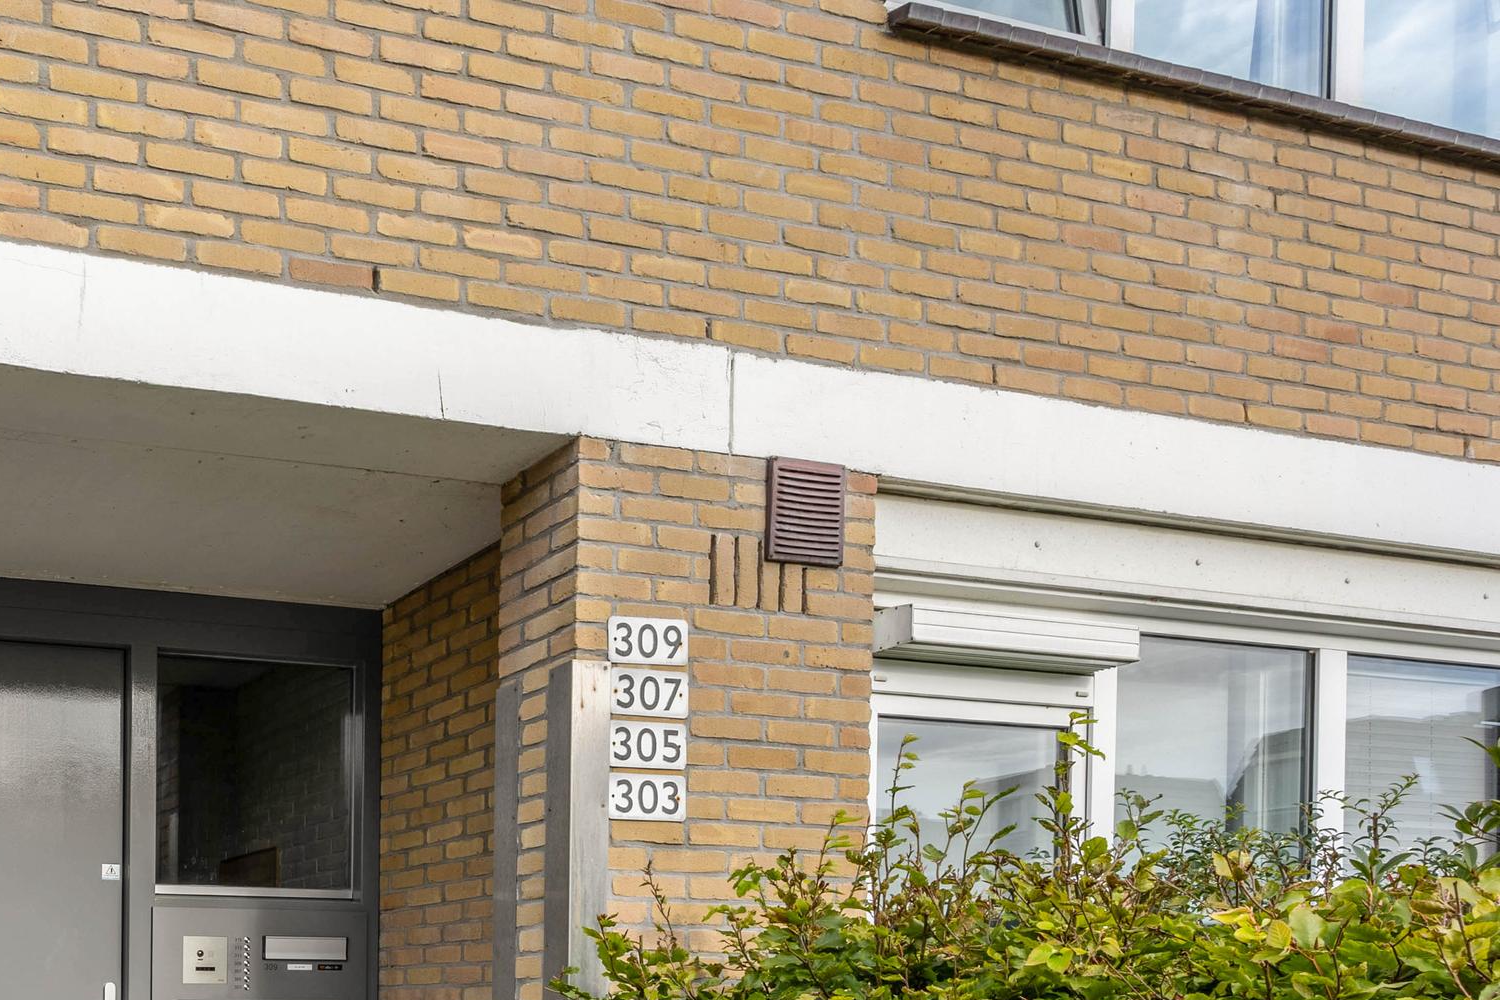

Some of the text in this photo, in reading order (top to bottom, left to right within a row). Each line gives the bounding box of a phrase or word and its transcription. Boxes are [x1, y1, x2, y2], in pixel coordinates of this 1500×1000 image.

[614, 622, 682, 659] 309
[616, 673, 682, 711] 307
[613, 726, 681, 763] 305
[614, 778, 680, 815] 303
[263, 963, 278, 971] 309
